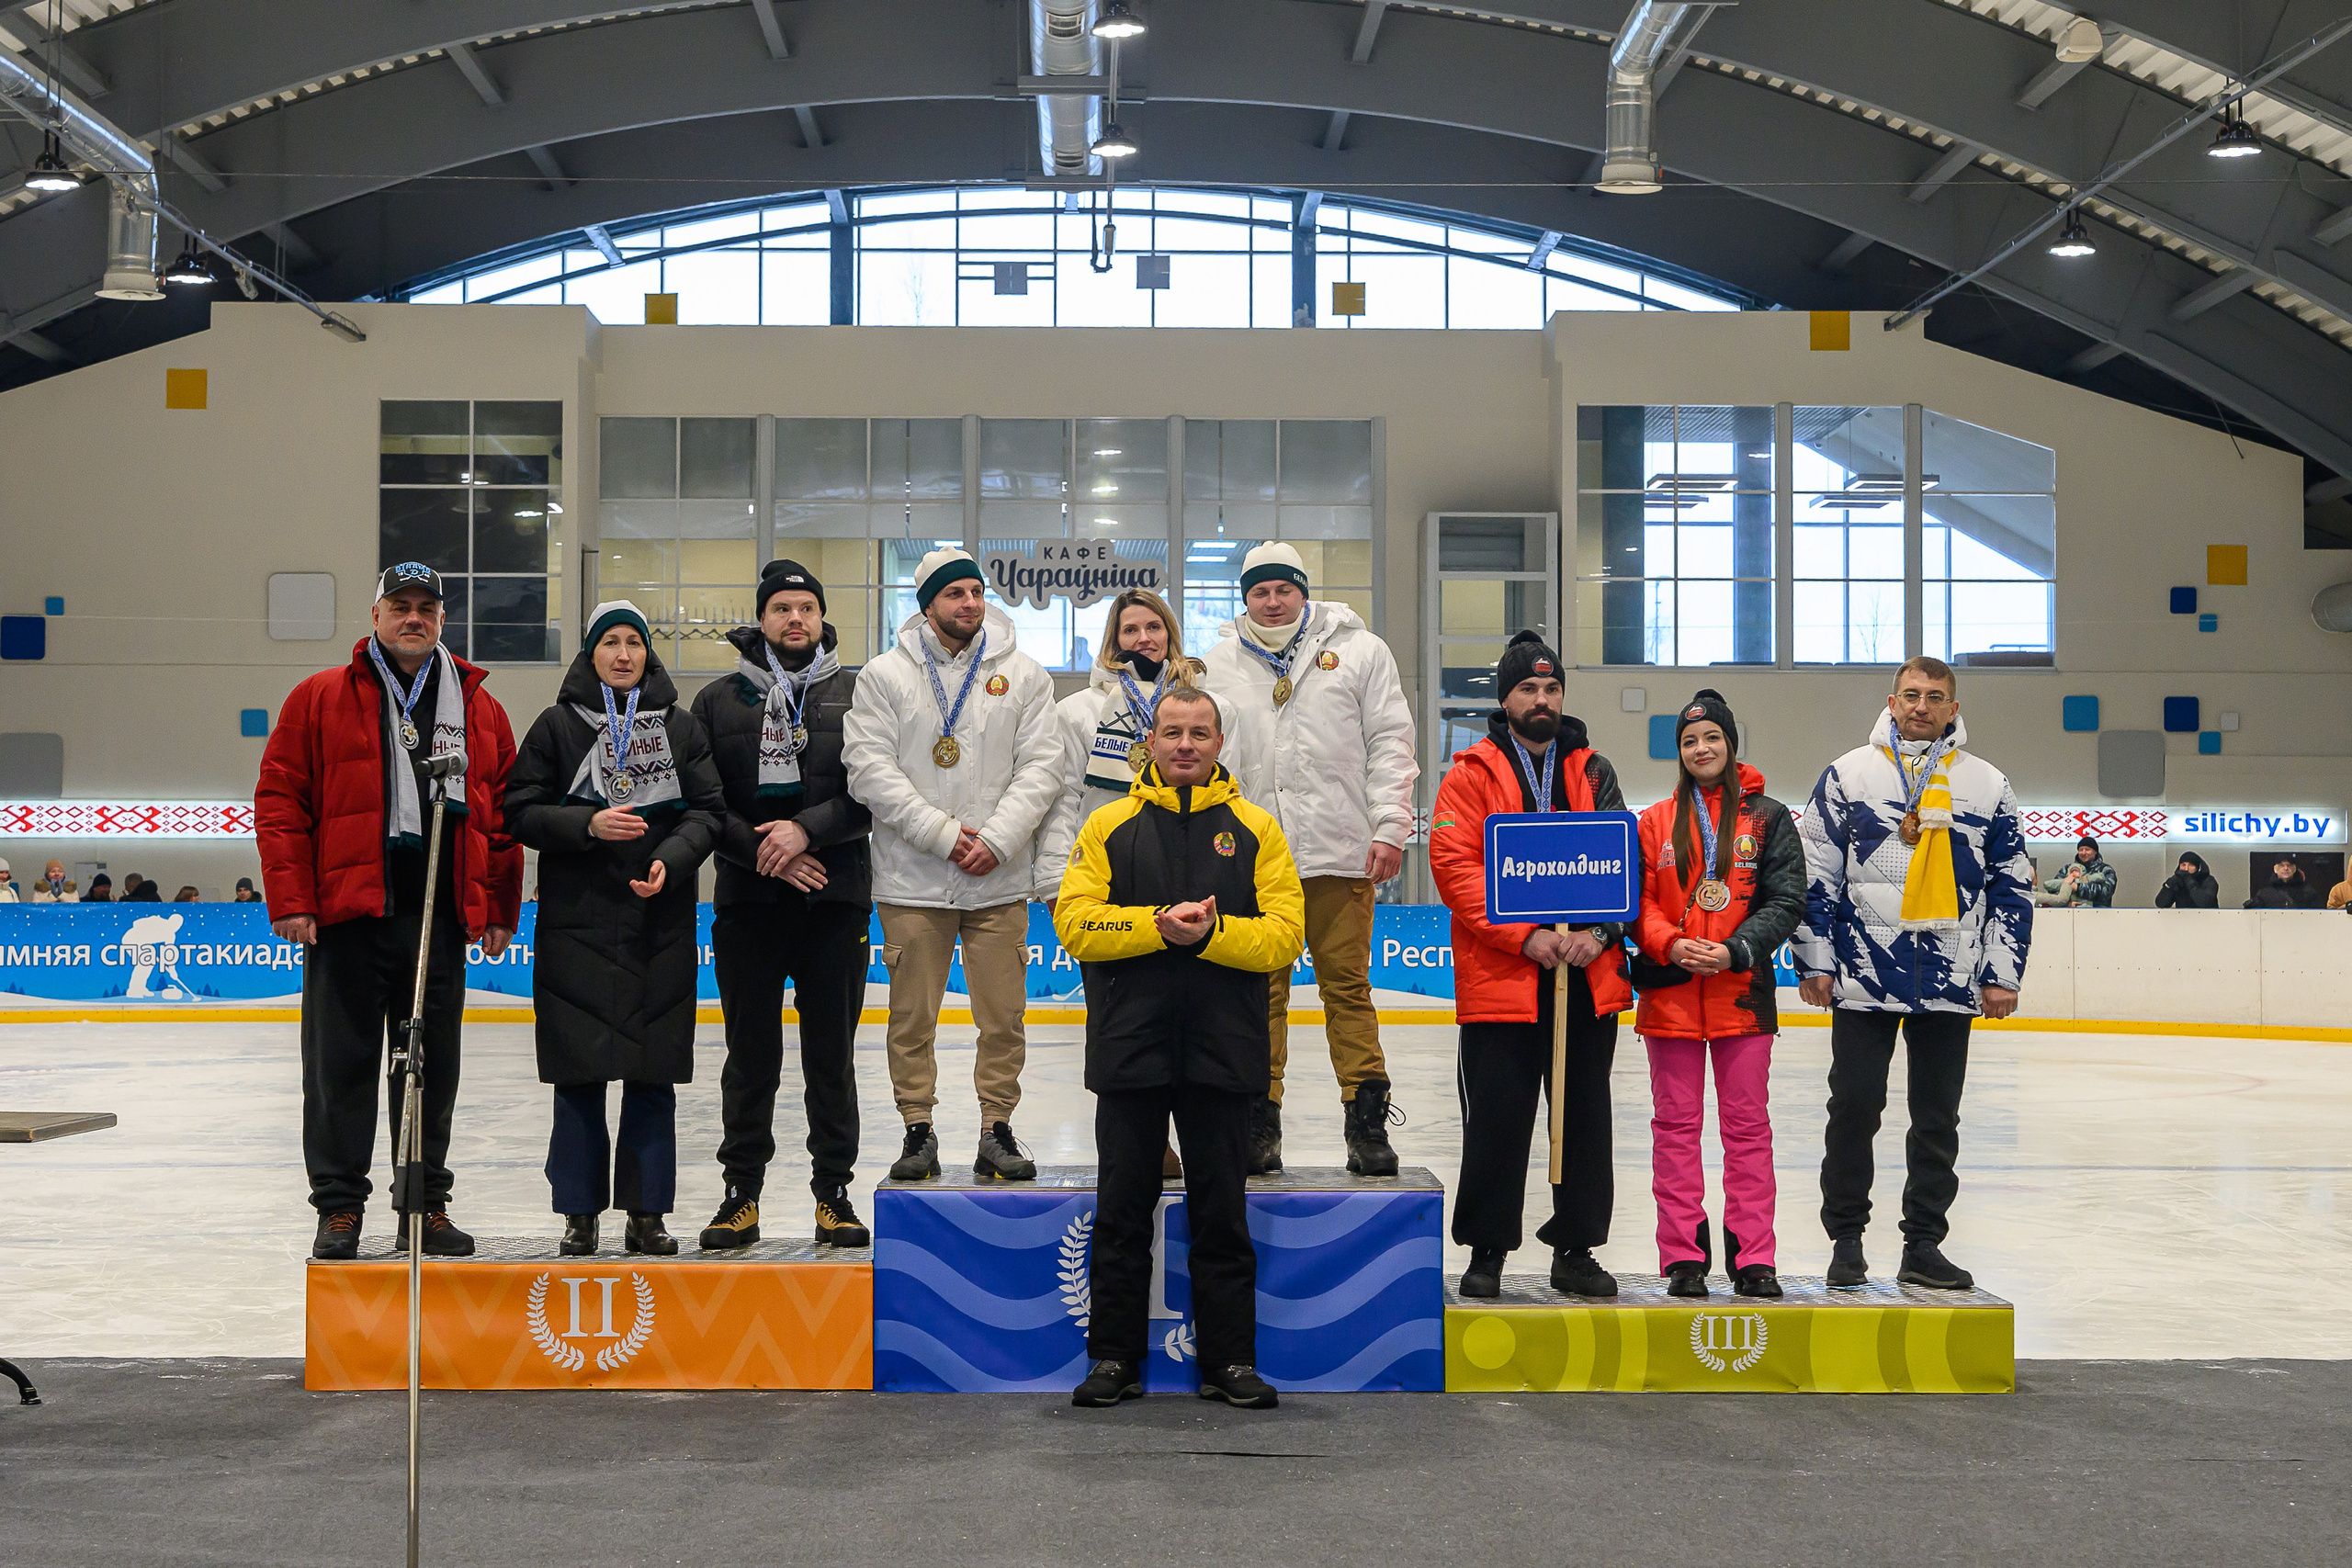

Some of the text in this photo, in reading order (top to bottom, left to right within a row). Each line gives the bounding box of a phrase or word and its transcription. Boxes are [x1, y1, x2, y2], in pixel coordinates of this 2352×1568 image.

[1044, 547, 1106, 560] КАФЕ
[604, 736, 664, 759] ЕИНЫЕ
[1094, 737, 1129, 753] БЕЛЫЕ
[2184, 812, 2331, 838] silichy.by
[1501, 853, 1623, 883] Агрохолдинг
[0, 944, 91, 966] мняя
[100, 944, 304, 973] спартакиада
[560, 1277, 621, 1337] II
[1702, 1315, 1756, 1350] III
